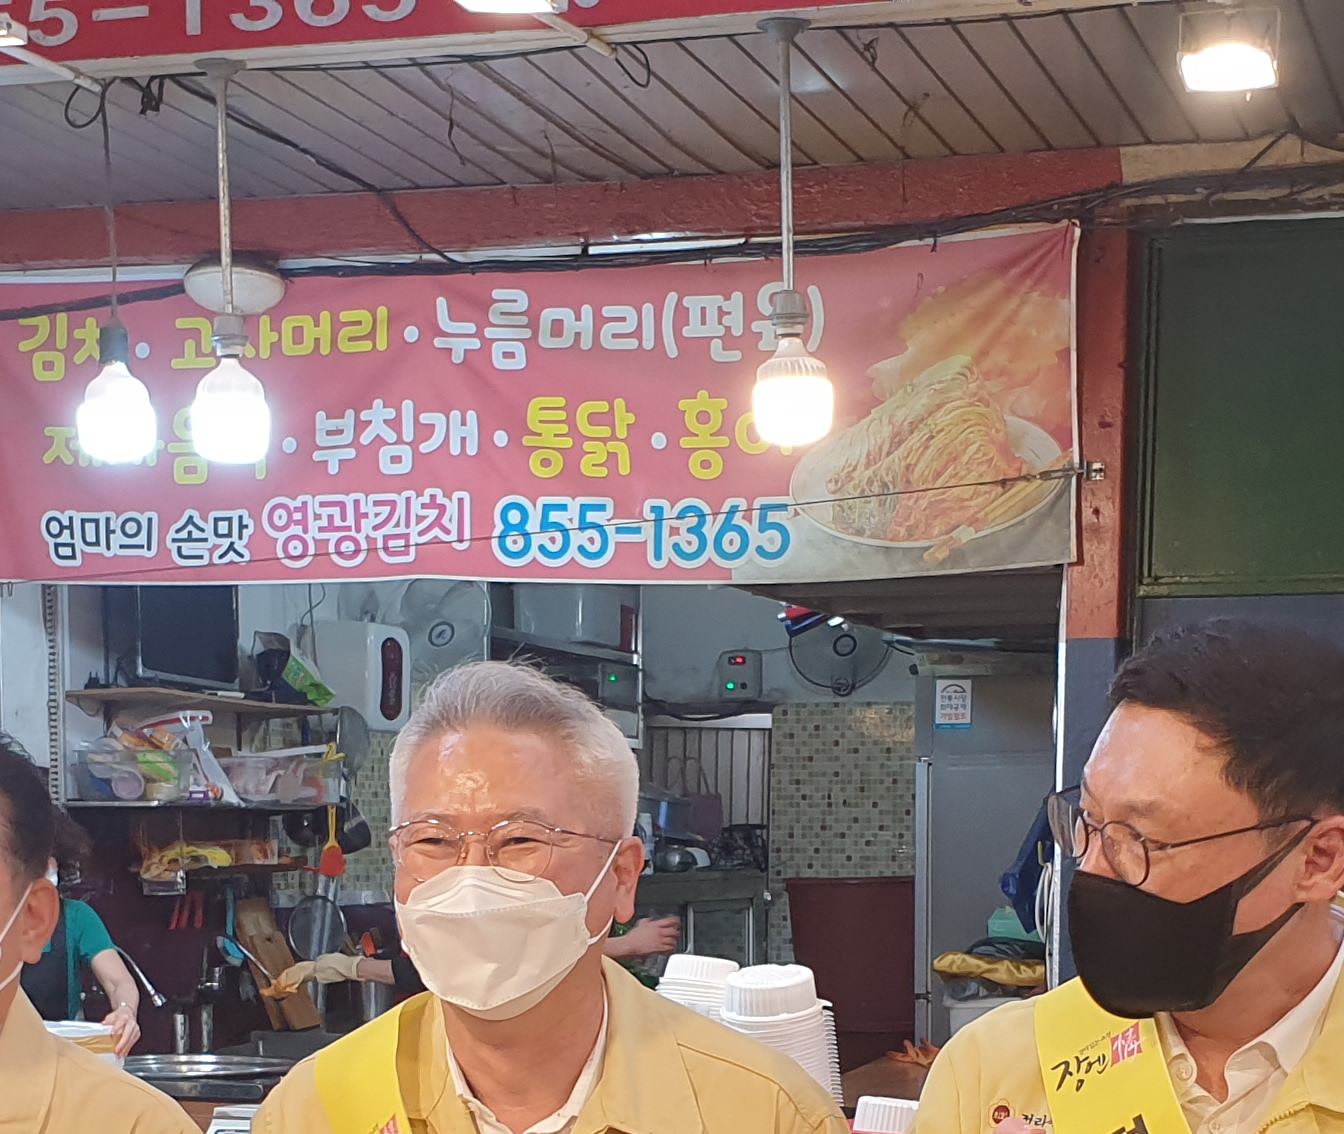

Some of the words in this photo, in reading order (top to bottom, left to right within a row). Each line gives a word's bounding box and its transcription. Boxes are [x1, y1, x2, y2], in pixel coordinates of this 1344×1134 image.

[313, 398, 480, 476] 부침개
[521, 396, 638, 479] 통닭
[44, 512, 155, 563] 엄마의
[169, 507, 254, 562] 손맛
[265, 490, 470, 564] 영광김치
[494, 500, 792, 564] 855-1365
